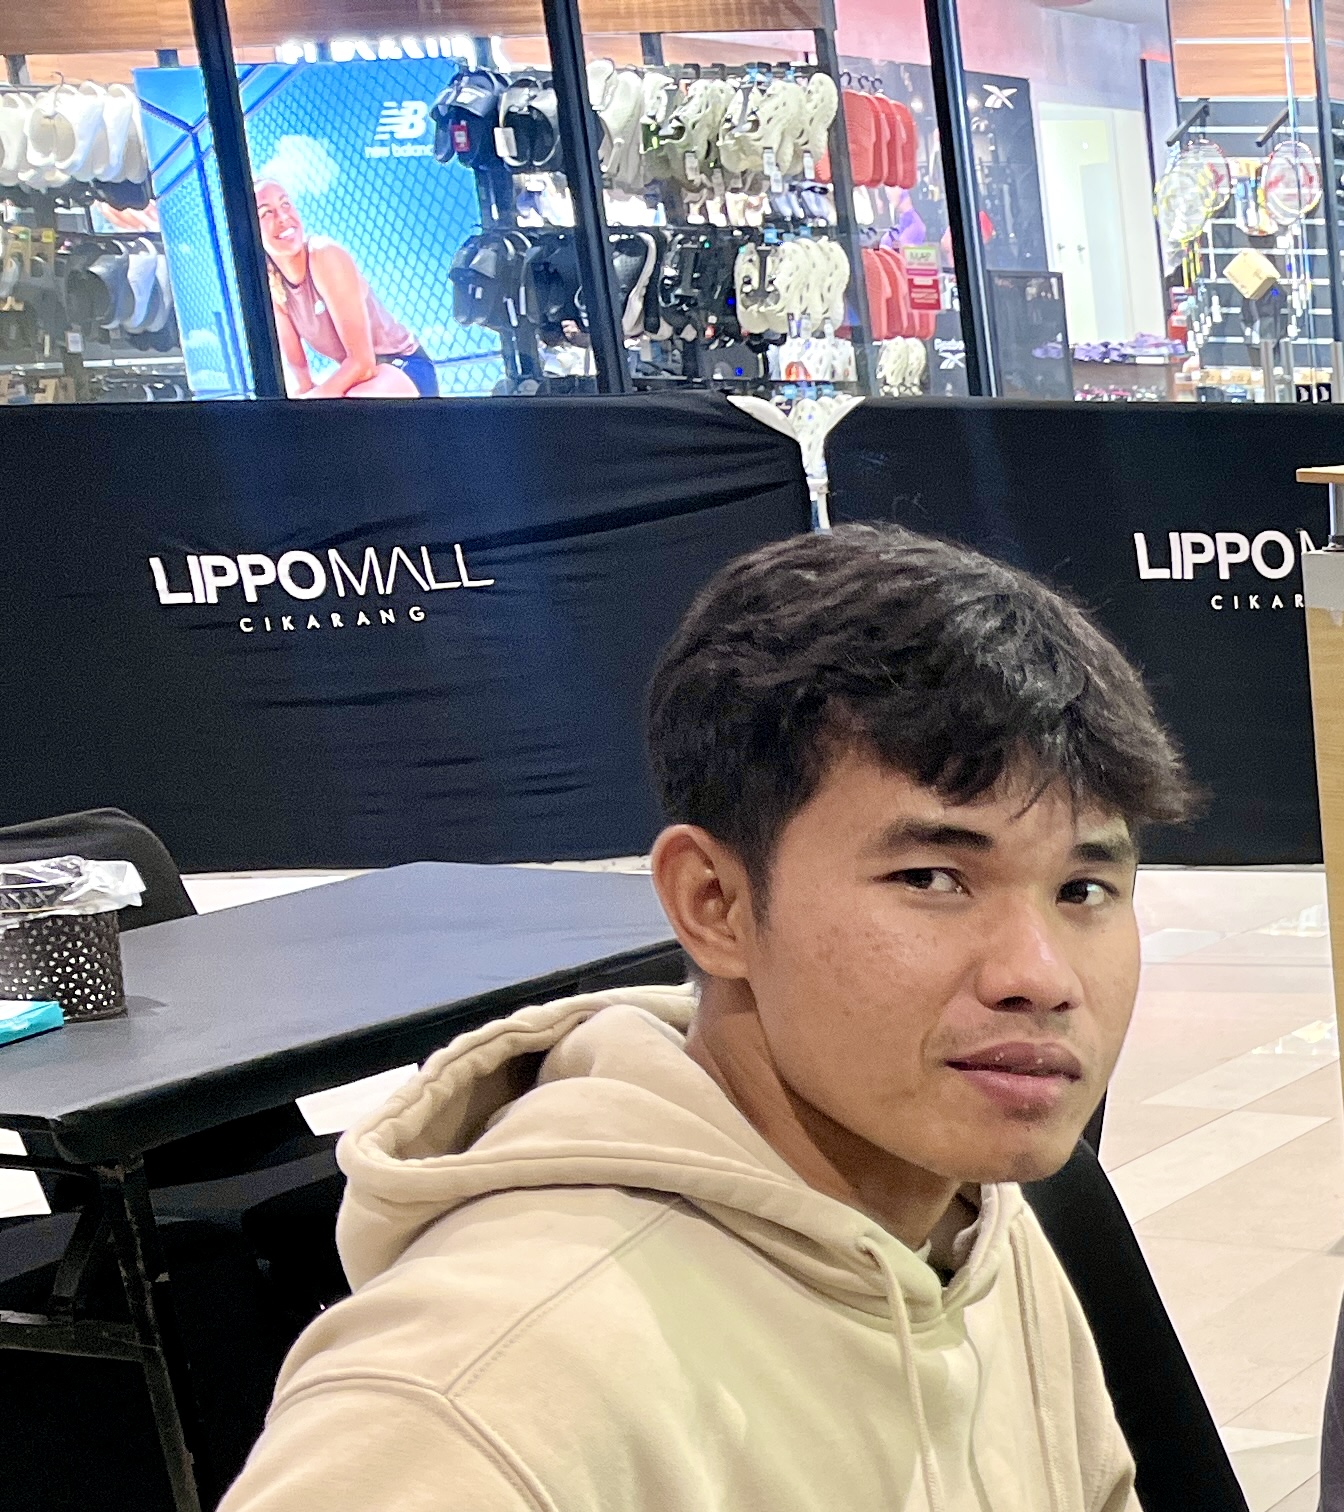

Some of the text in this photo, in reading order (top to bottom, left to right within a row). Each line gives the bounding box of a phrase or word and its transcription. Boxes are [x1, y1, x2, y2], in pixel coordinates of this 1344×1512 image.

[391, 142, 433, 158] balanc
[1210, 594, 1306, 610] CIKAR
[238, 605, 426, 633] CIKARANG
